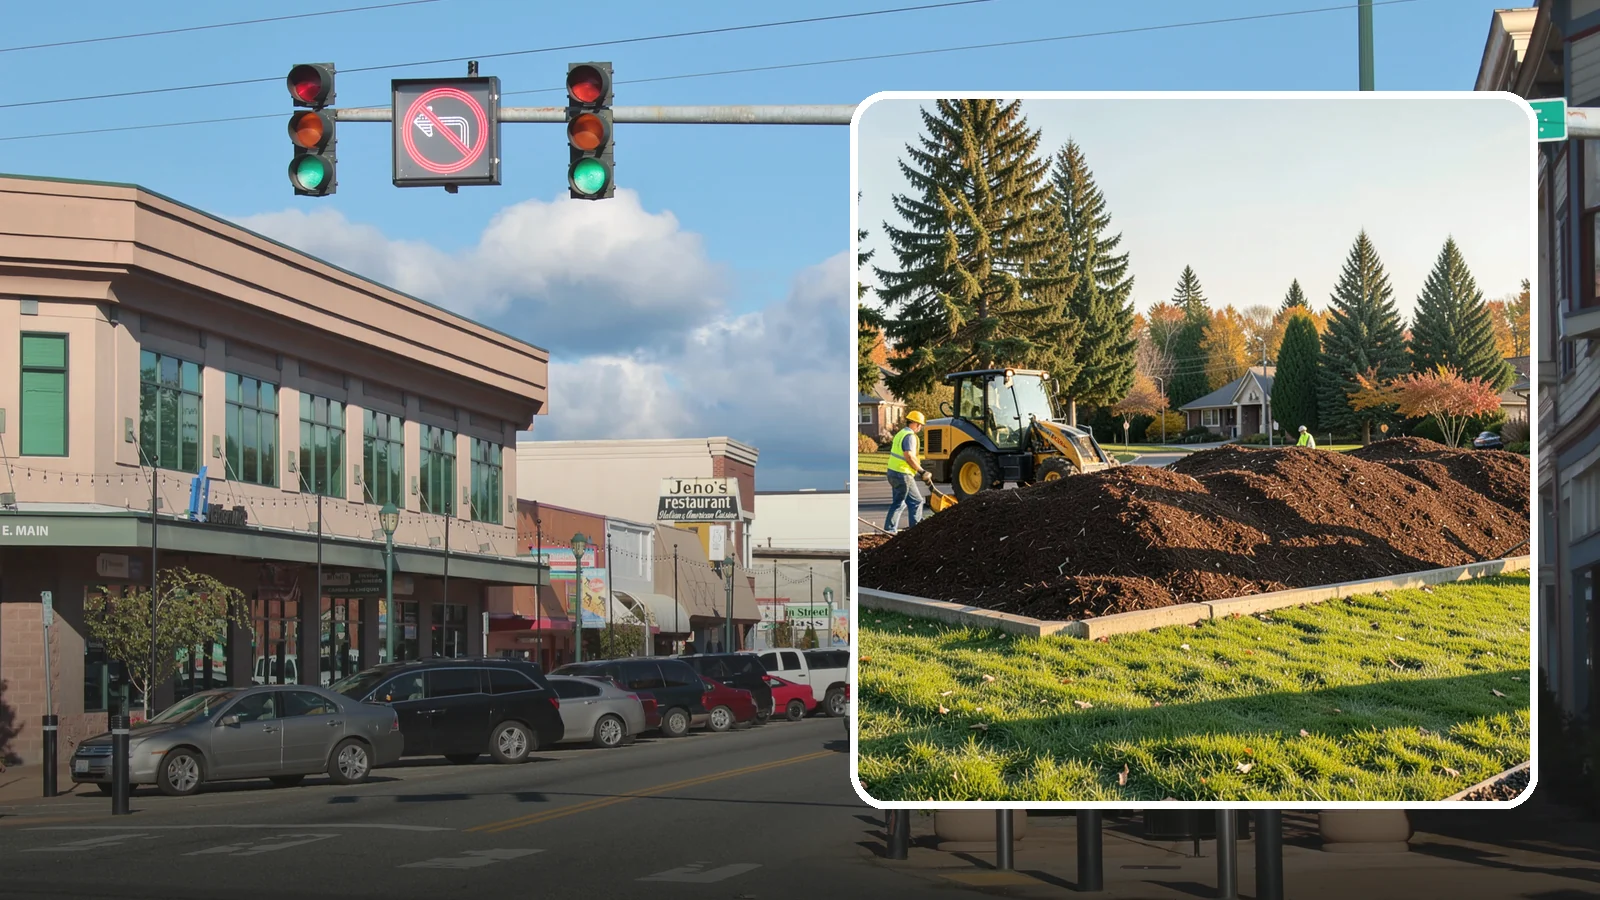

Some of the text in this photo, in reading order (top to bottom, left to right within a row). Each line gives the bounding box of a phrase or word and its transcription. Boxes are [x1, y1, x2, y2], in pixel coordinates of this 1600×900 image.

[670, 480, 727, 494] Jeno's
[665, 497, 731, 509] restaurant
[686, 510, 714, 519] American
[715, 509, 738, 519] Cuisine
[2, 525, 49, 536] E. MAIN
[797, 608, 828, 616] Street
